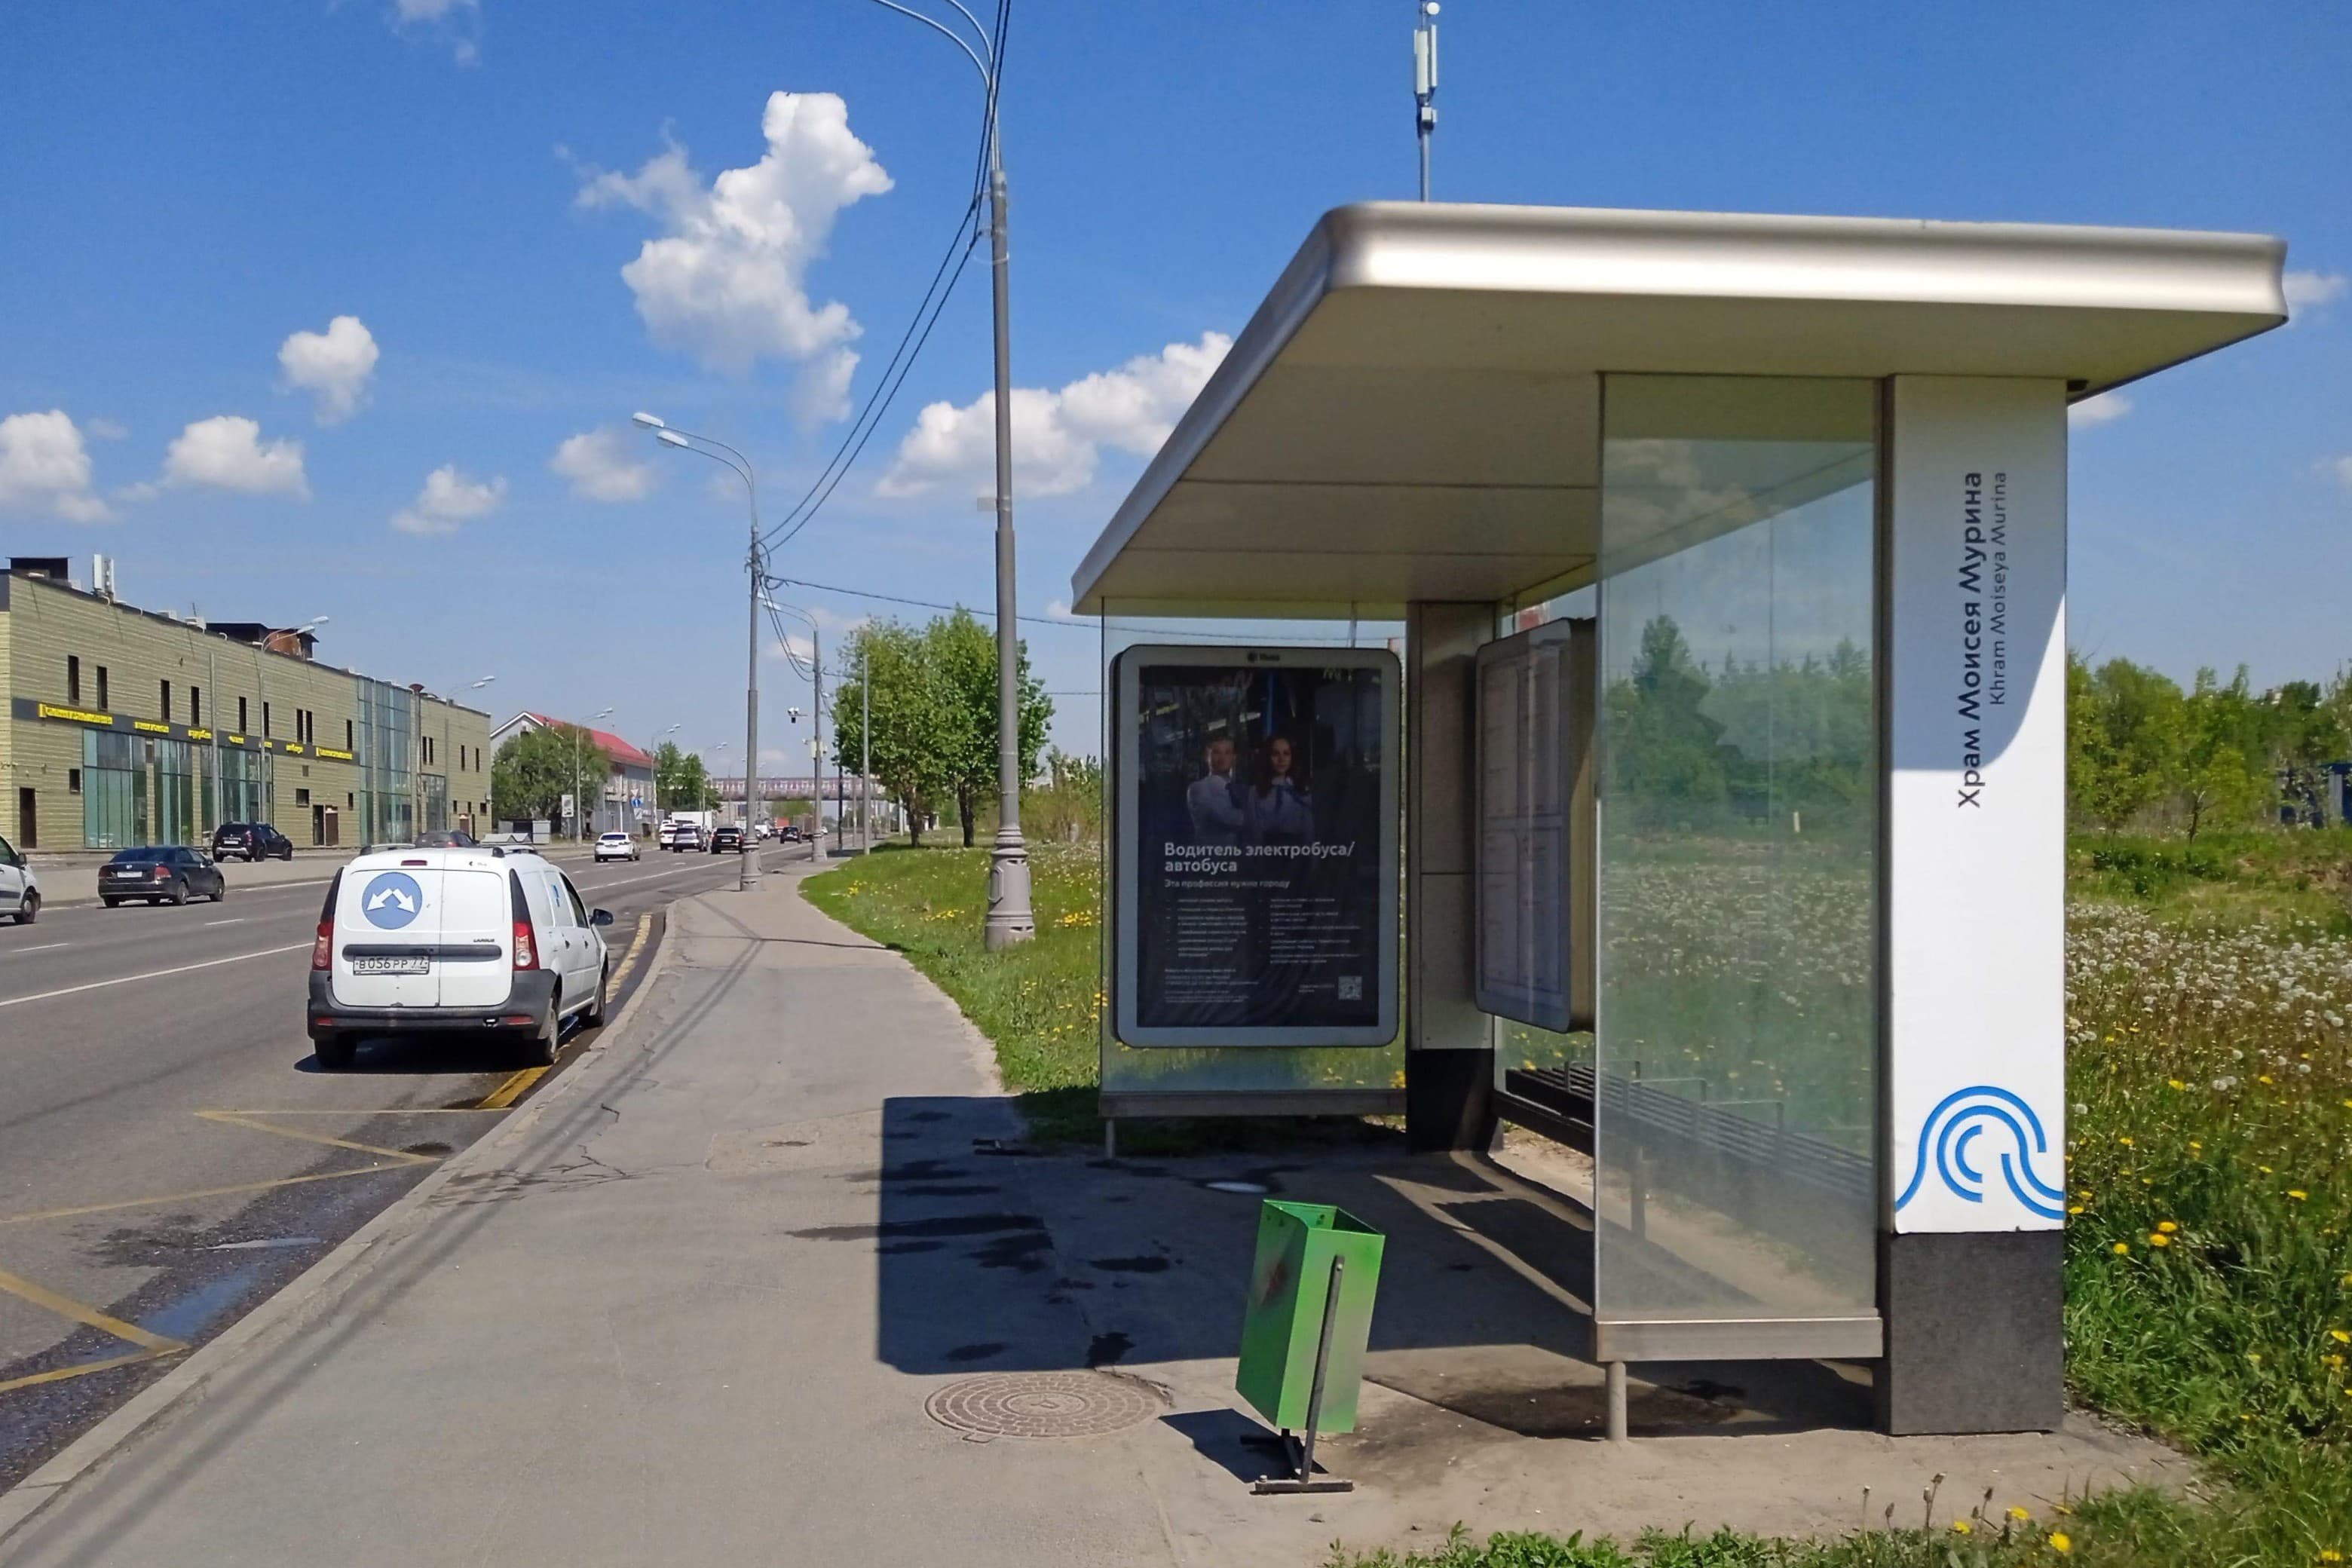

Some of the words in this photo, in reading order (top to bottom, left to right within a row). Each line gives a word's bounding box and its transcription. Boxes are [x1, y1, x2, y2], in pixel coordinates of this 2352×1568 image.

[1959, 471, 1987, 594] Мурина
[1992, 471, 2007, 547] Murina
[1991, 550, 2010, 635] Moiseya
[1958, 601, 1983, 721] Моисея
[1990, 639, 2007, 705] Khram
[1958, 729, 1986, 809] Храм
[1164, 841, 1242, 858] Водитель
[1245, 841, 1355, 859] электробуса/
[1164, 858, 1238, 874] автобуса
[1164, 879, 1180, 888] Эта
[1181, 879, 1229, 889] профессия
